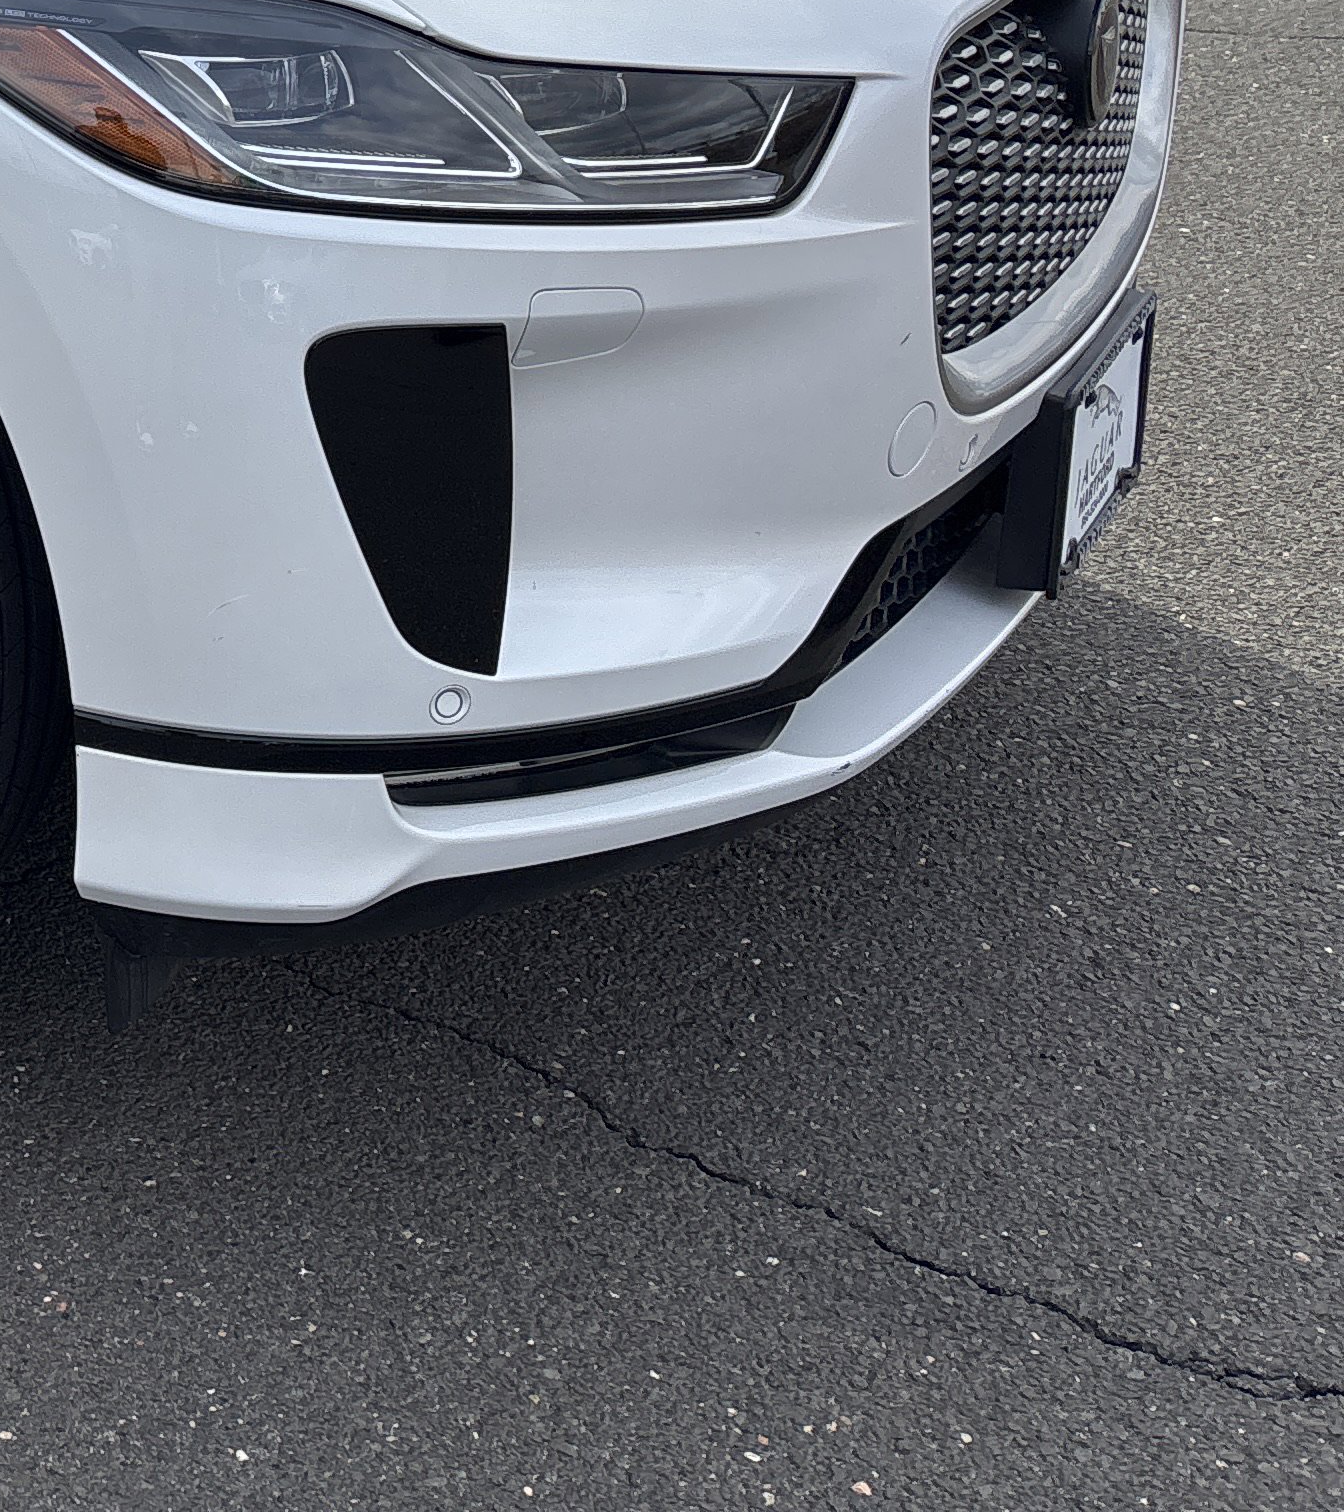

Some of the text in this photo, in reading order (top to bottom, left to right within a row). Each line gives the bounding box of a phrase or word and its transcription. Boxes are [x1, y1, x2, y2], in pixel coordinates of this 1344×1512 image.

[27, 11, 93, 24] TECHNOLOGY
[1075, 410, 1123, 509] JAGUAR
[1078, 451, 1114, 518] HARTFORD
